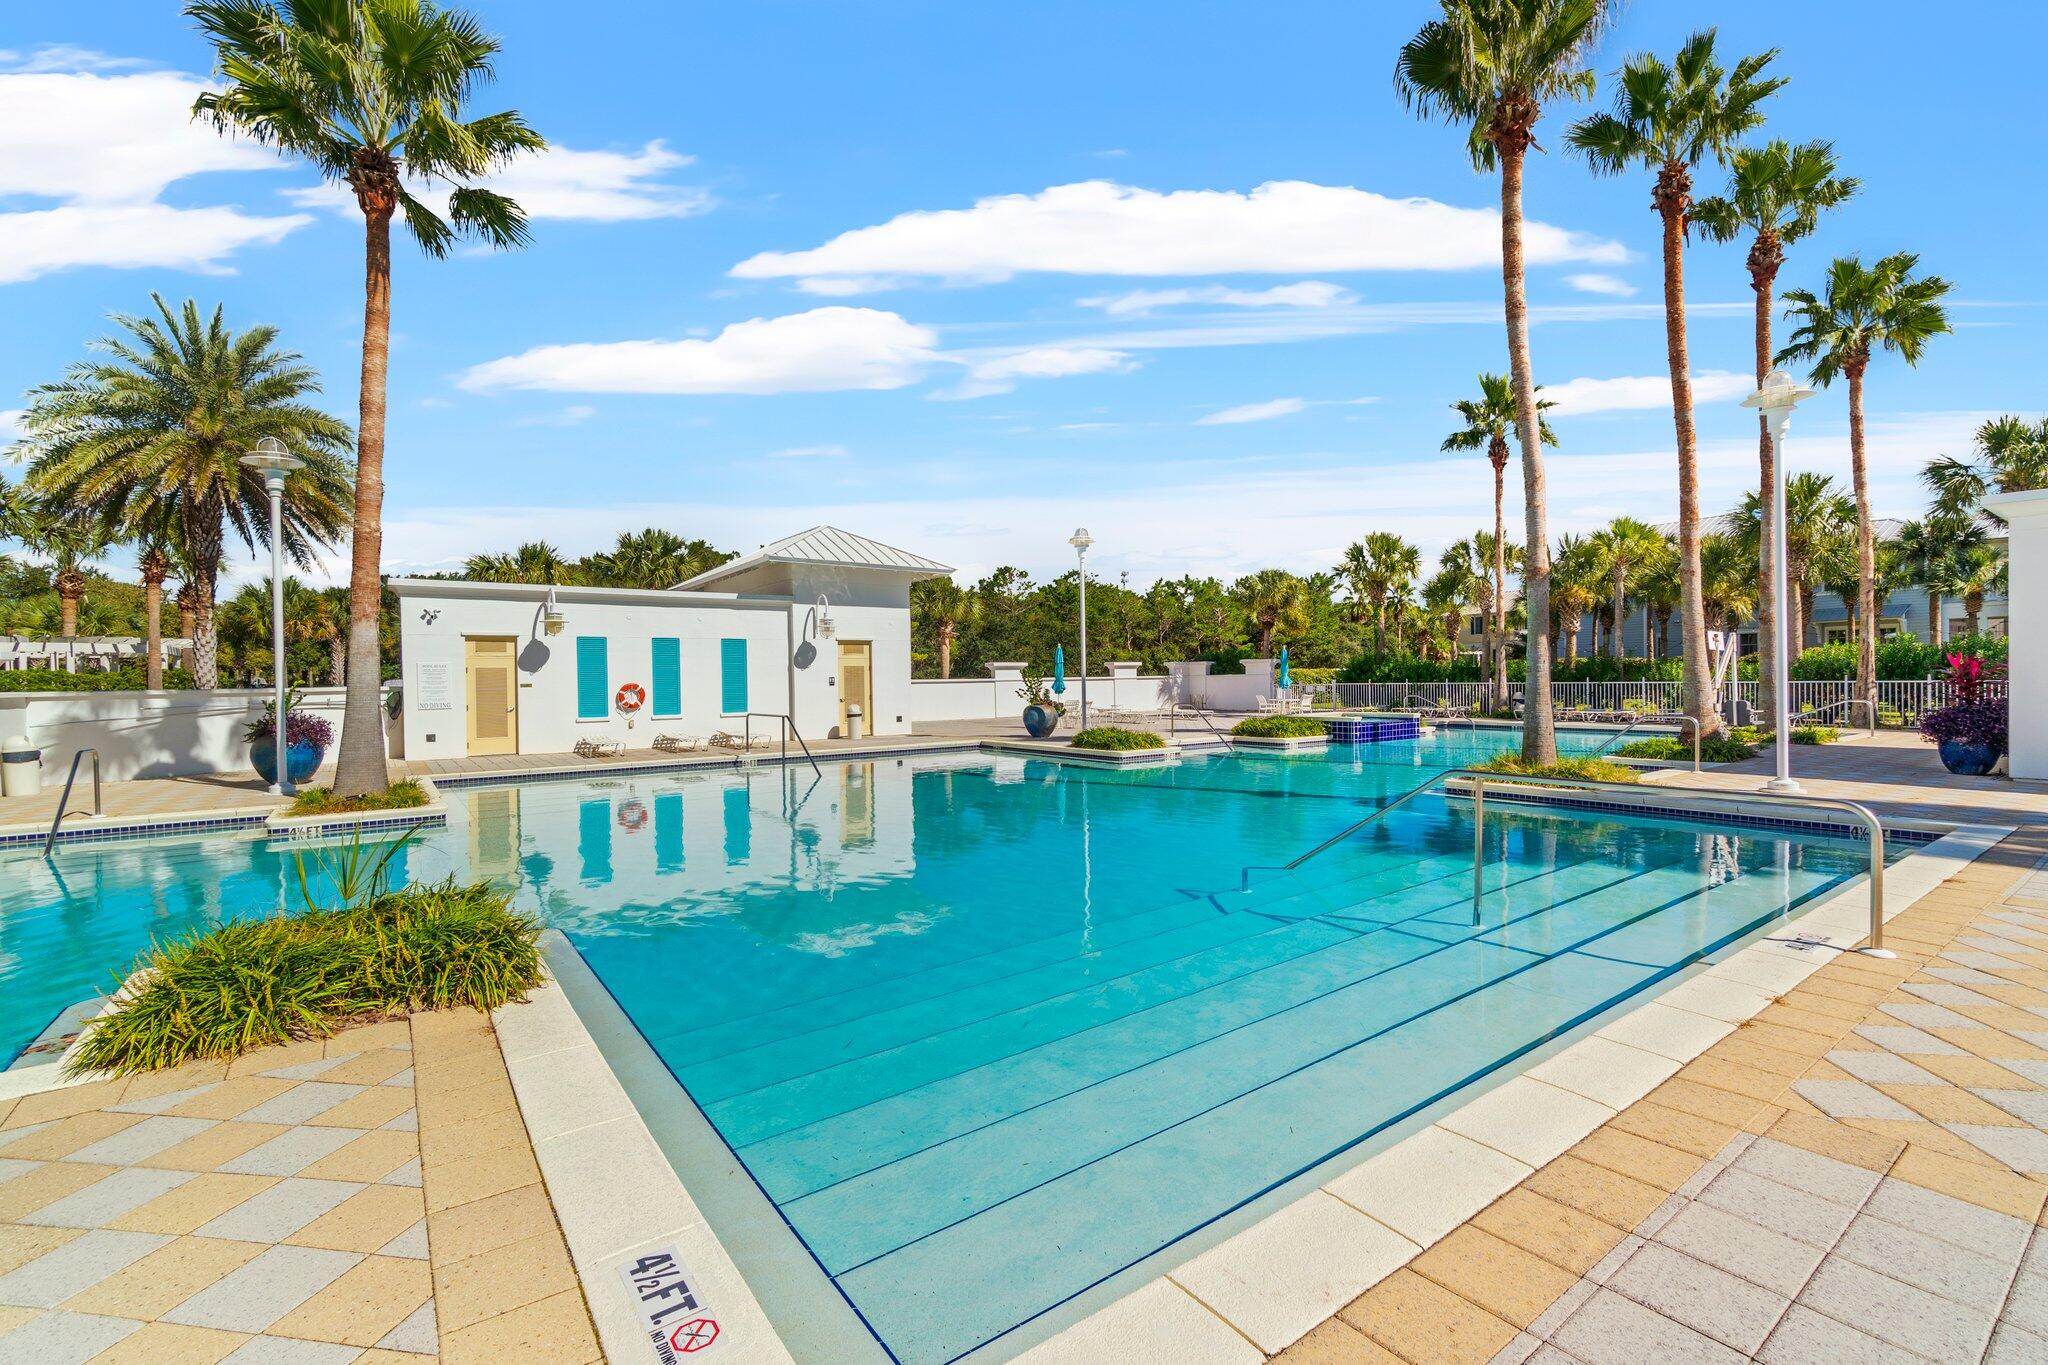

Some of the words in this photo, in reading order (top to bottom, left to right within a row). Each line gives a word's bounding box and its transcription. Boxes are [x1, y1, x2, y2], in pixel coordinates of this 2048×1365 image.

[641, 1279, 699, 1326] FT.
[650, 1330, 666, 1343] NO
[656, 1341, 678, 1365] DIVING
